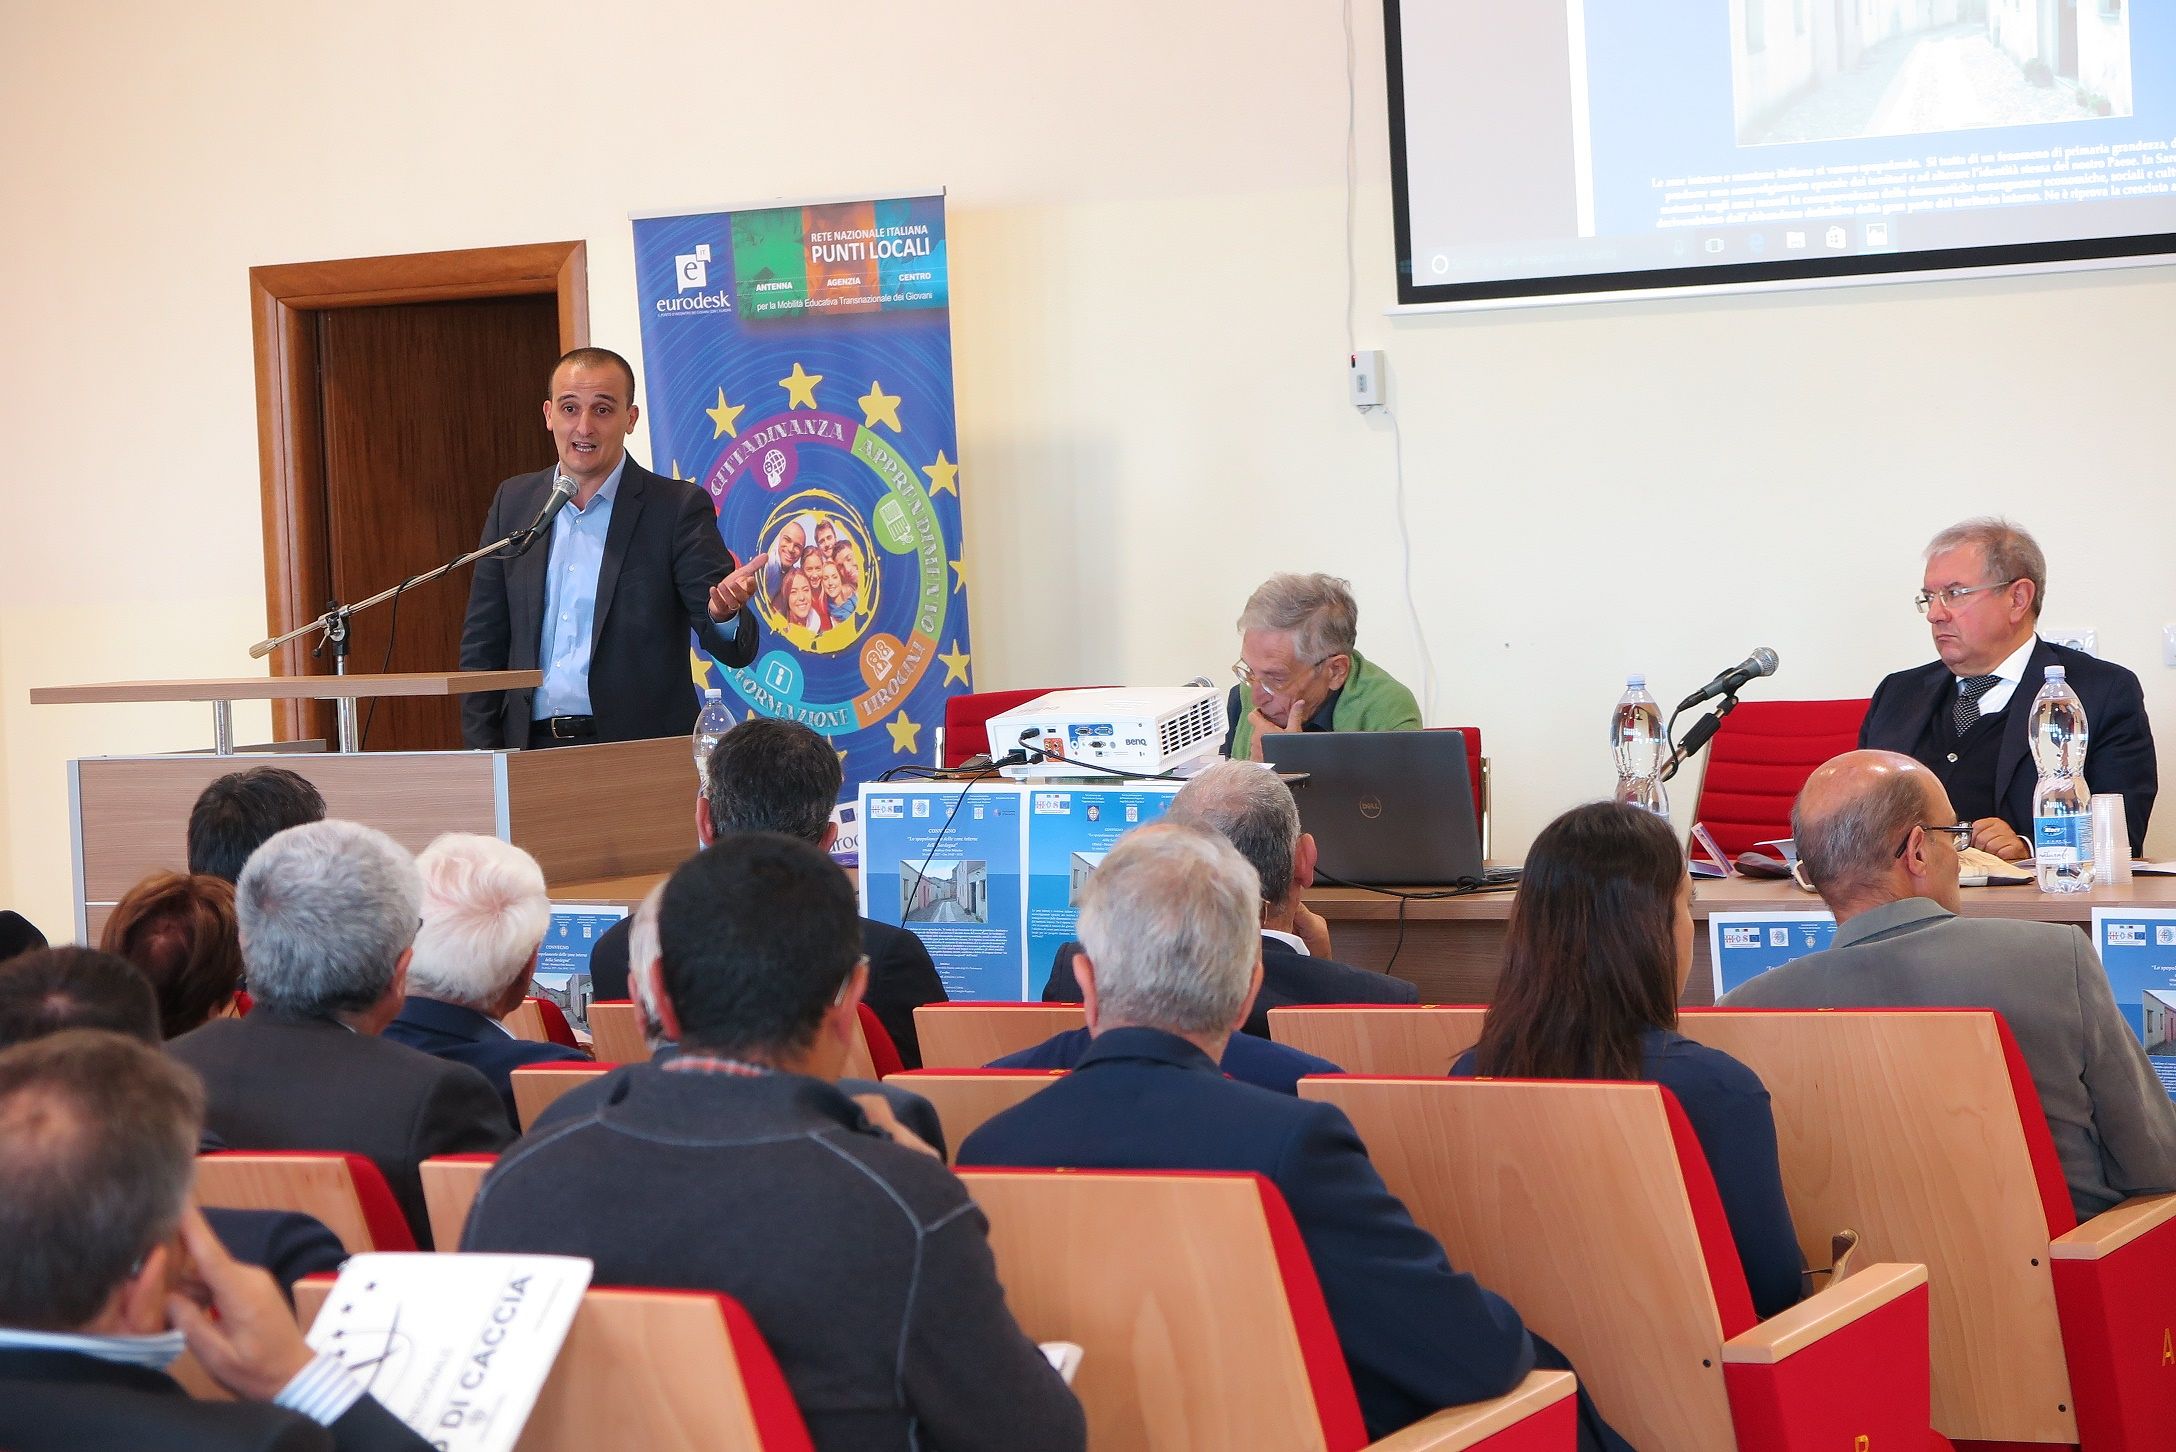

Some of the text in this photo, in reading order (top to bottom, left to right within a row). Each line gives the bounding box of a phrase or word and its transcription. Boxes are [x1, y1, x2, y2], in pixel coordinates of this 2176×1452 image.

[2051, 148, 2062, 157] di
[2065, 144, 2109, 159] primaria
[2112, 141, 2168, 156] grandezza,
[2053, 160, 2069, 171] del
[2072, 159, 2105, 170] nostro
[2107, 157, 2139, 167] Paese.
[2142, 154, 2153, 164] In
[2111, 168, 2144, 182] sociali
[2147, 171, 2153, 179] e
[2044, 190, 2059, 200] Ne
[2111, 186, 2120, 196] la
[811, 225, 928, 242] RETE NAZIONALE ITALIANA
[812, 238, 930, 263] PUNTI LOCALI
[827, 277, 861, 286] AGENZIA
[899, 272, 932, 282] CENTRO
[756, 282, 793, 292] ANTENNA
[656, 290, 731, 312] eurodesk
[756, 303, 768, 312] per
[770, 302, 776, 310] la
[777, 299, 804, 309] Mobilità
[804, 298, 838, 308] Educativa
[838, 294, 891, 305] Transnazionale
[906, 291, 933, 300] Giovani
[710, 418, 845, 497] CITTADINANZA
[859, 438, 939, 633] APPRENDIMENTO
[860, 640, 926, 716] TIROCINI
[727, 666, 848, 728] FORMAZIONE
[1126, 738, 1147, 746] BenQ
[440, 1275, 533, 1429] DI CACCIA
[2162, 1328, 2176, 1366] A
